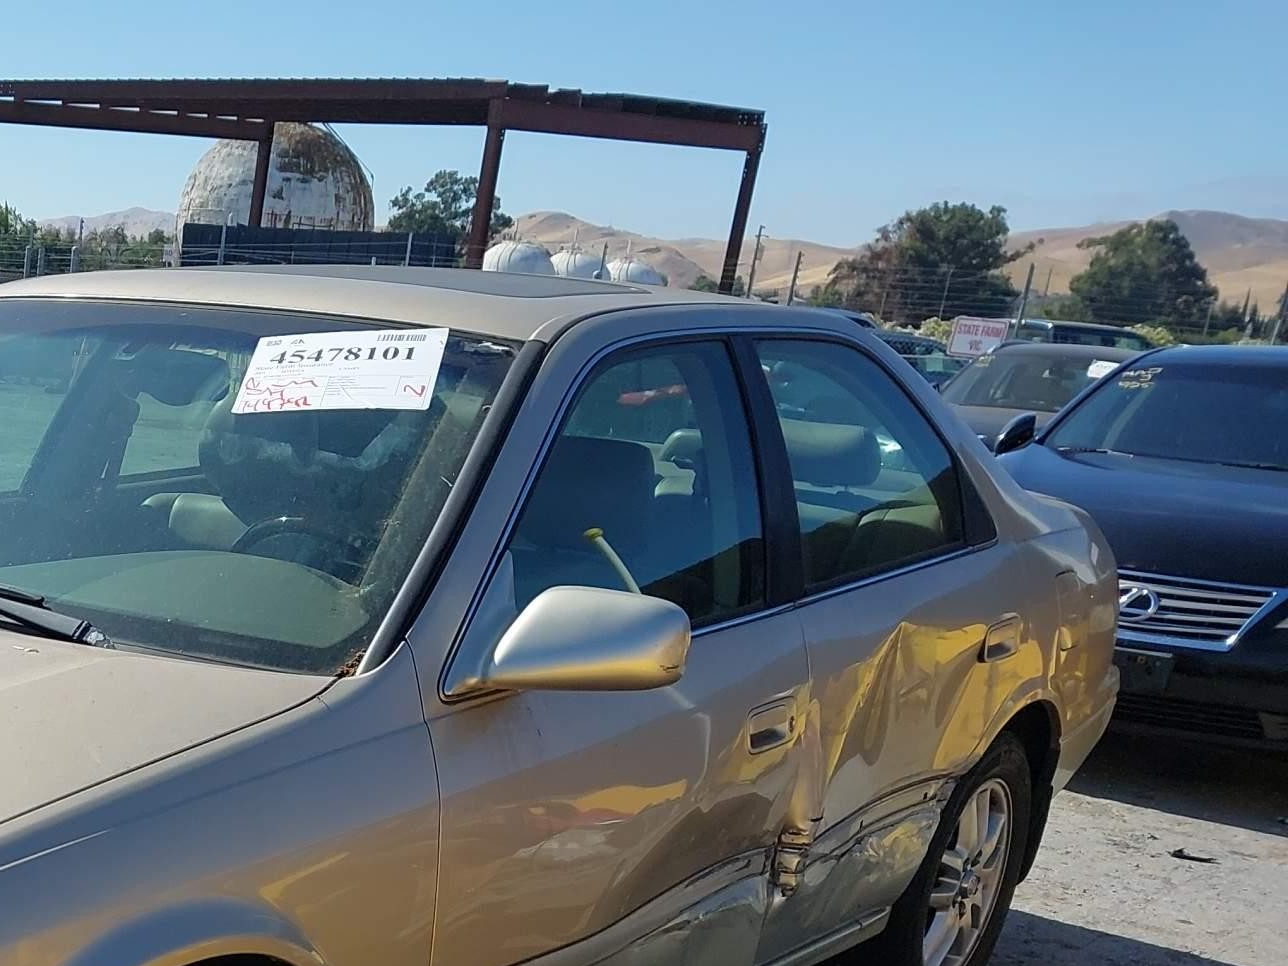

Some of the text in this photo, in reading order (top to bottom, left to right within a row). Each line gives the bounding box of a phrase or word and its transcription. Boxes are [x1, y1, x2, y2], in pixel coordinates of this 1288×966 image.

[958, 323, 1004, 337] STATE FARM
[269, 345, 416, 365] 45478101
